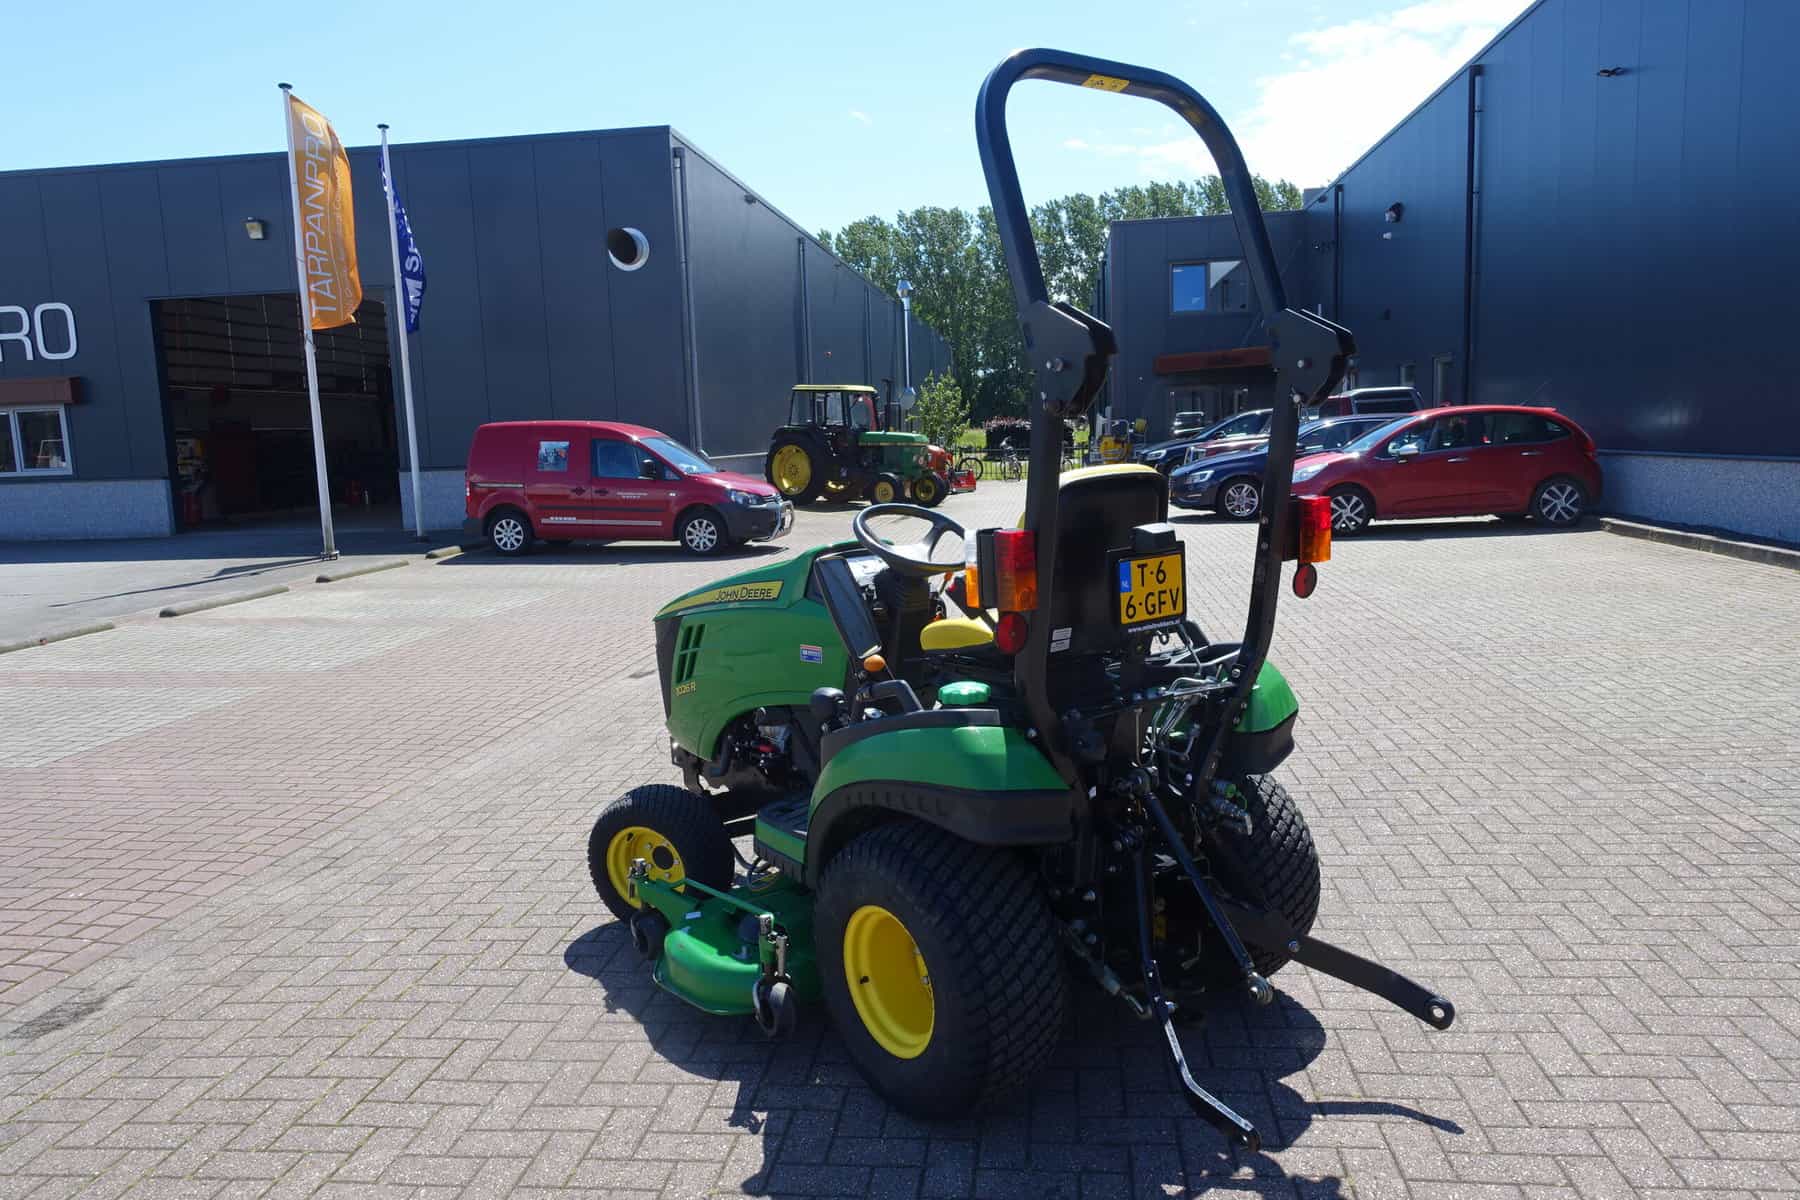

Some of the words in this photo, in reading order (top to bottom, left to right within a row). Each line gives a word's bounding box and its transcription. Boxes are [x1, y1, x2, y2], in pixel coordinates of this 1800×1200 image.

[302, 111, 337, 318] TARPANPRO
[716, 588, 739, 601] JOHN
[739, 586, 774, 599] DEERE
